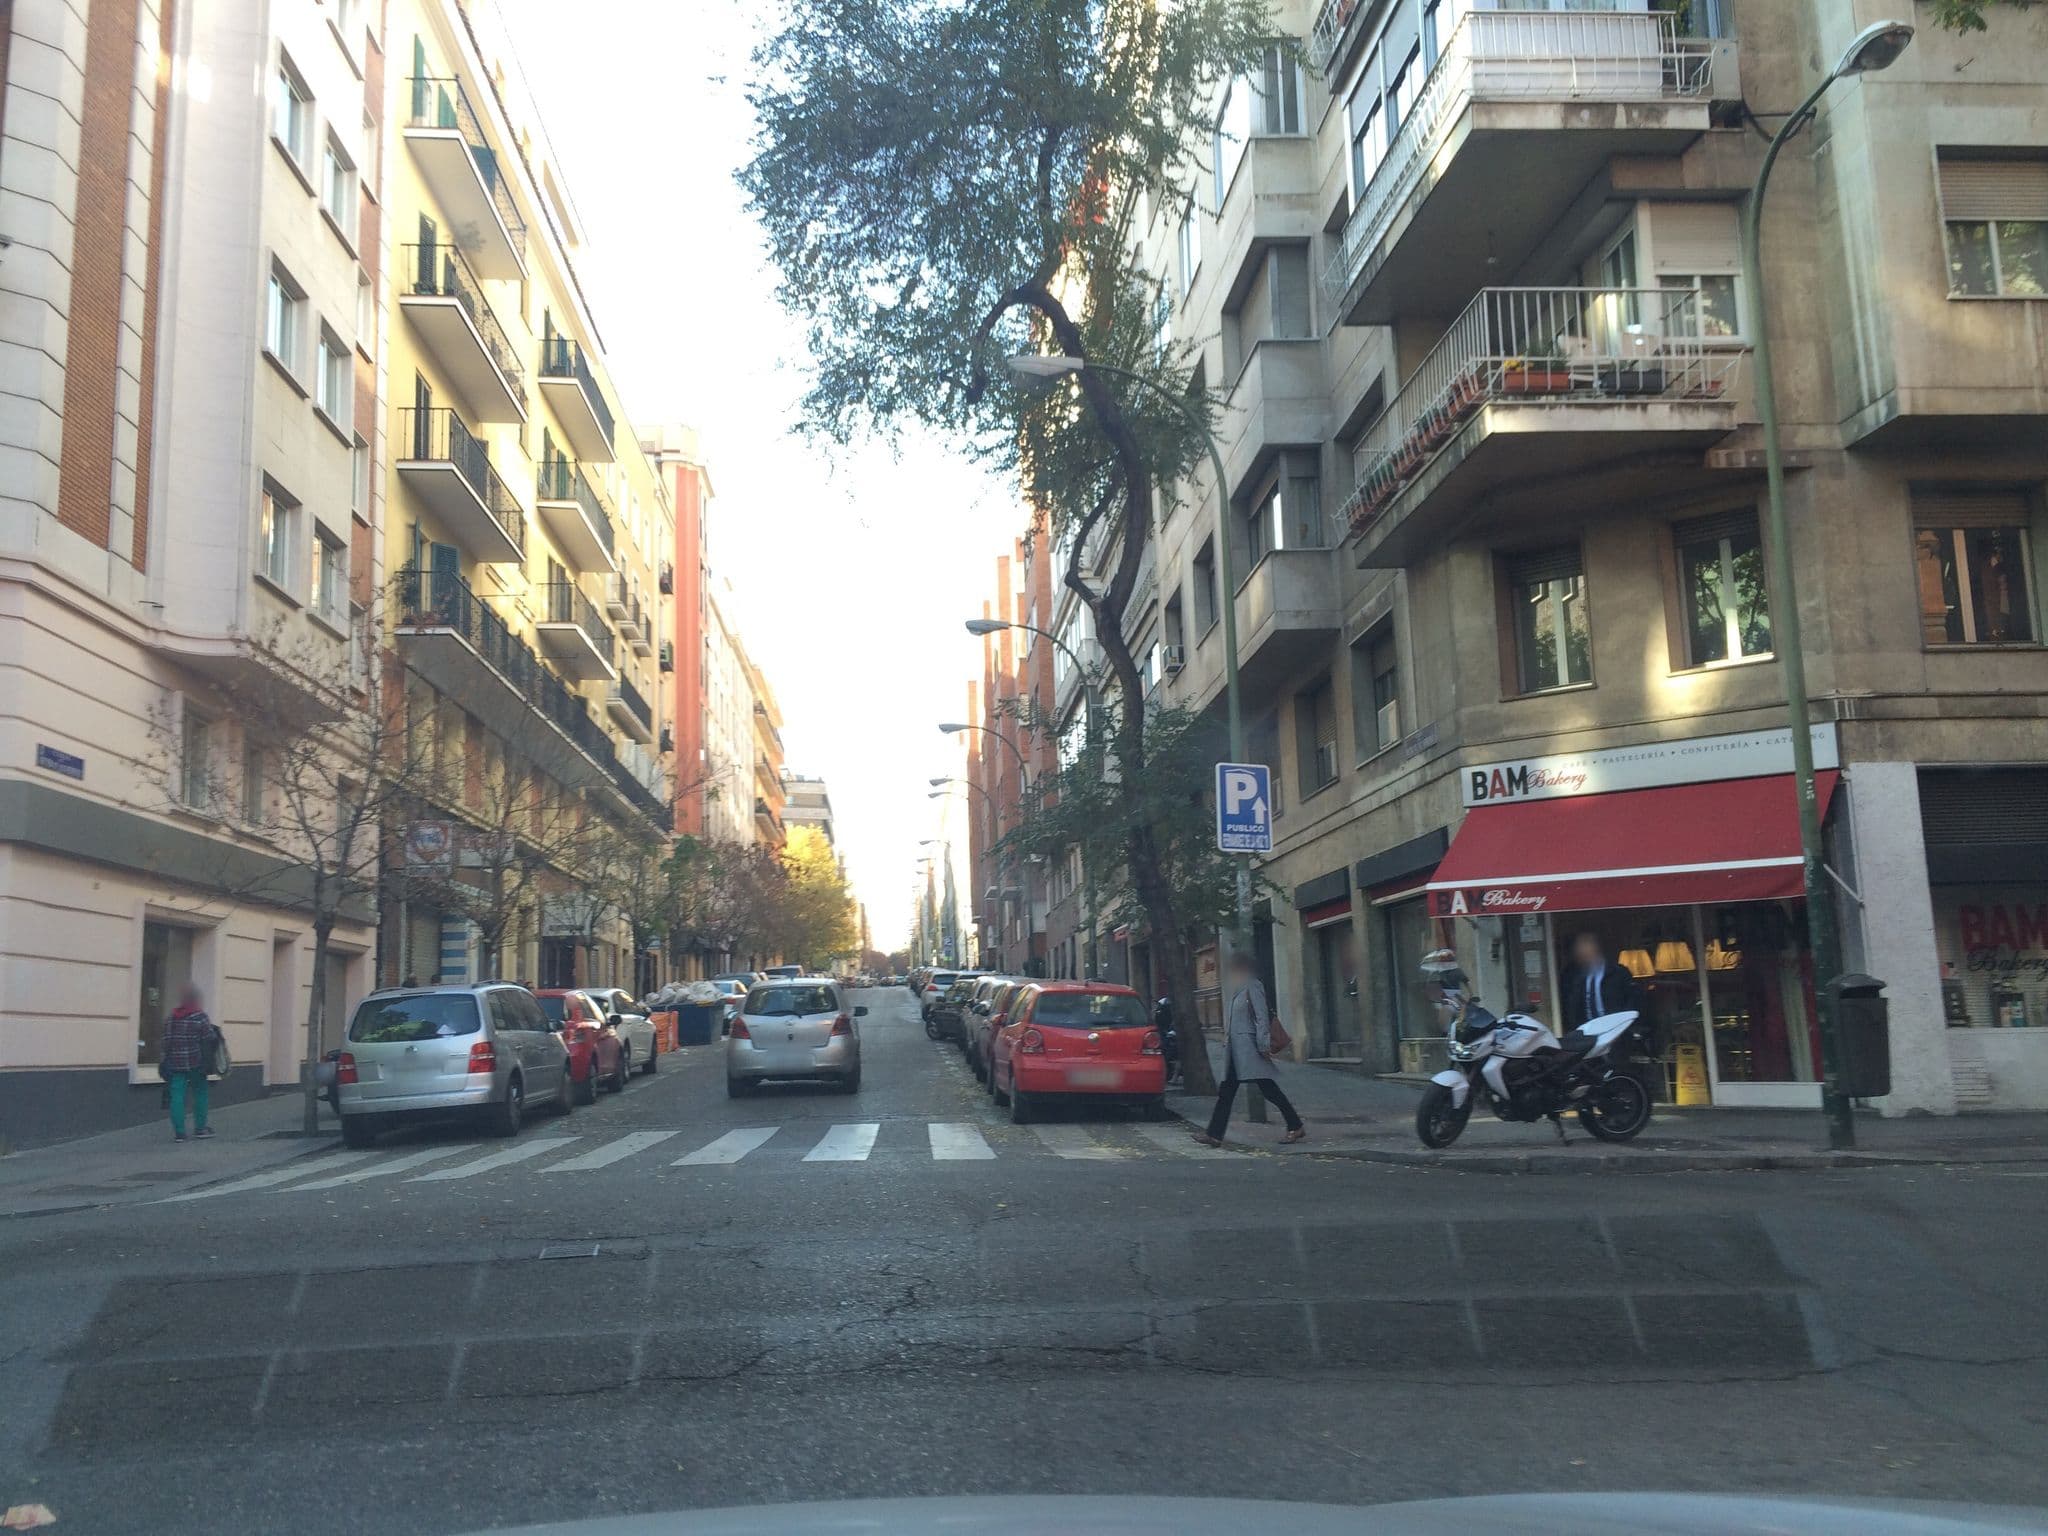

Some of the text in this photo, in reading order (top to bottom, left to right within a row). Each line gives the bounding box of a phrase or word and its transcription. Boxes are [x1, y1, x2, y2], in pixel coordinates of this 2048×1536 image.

[1680, 741, 1750, 756] CONFITERÍA
[1225, 772, 1258, 815] P
[1471, 765, 1588, 801] BAM Bakery
[1226, 823, 1265, 833] PUBLICO
[1436, 889, 1547, 915] BAM Bakery
